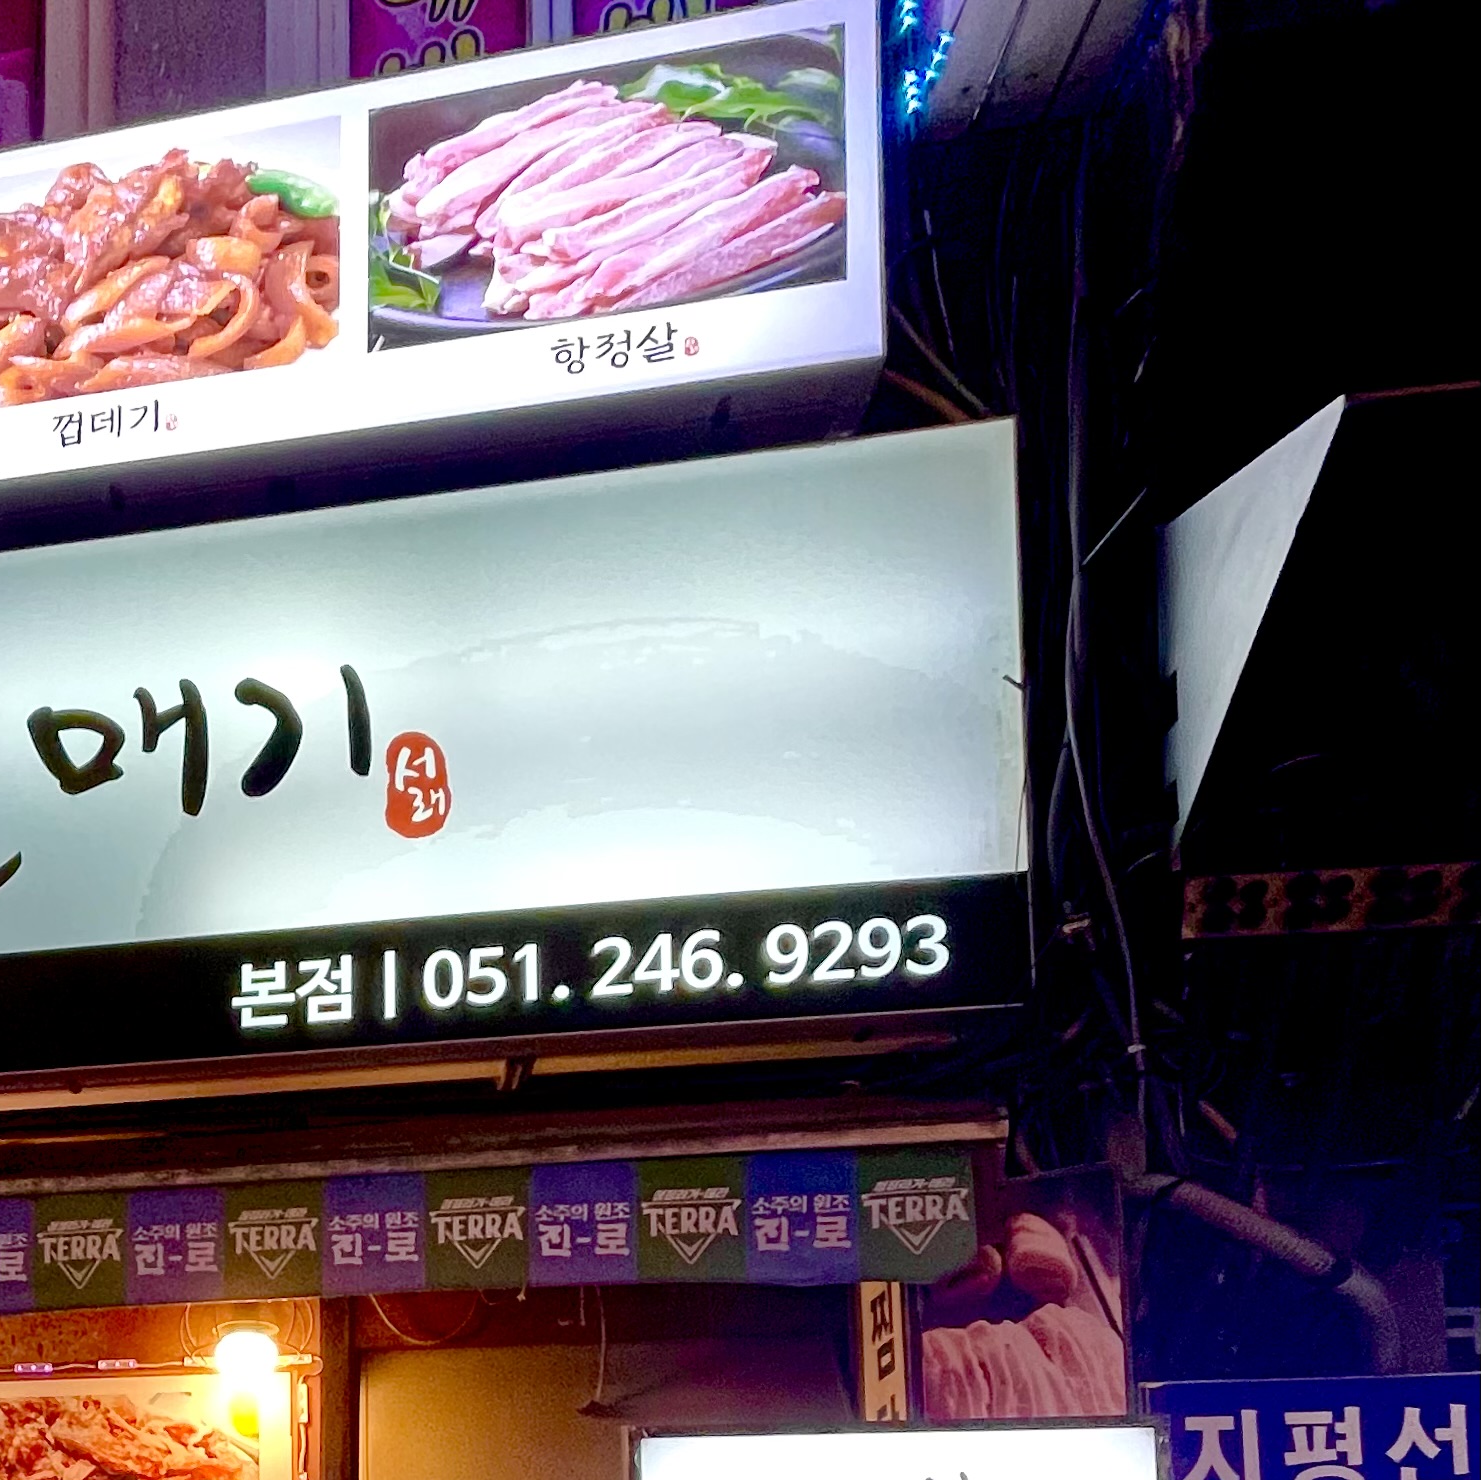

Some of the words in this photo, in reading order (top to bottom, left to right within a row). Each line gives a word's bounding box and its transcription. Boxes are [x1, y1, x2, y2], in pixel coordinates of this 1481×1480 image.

[551, 324, 678, 373] 항정살
[52, 399, 159, 448] 껍데기
[230, 952, 353, 1028] 본점
[423, 942, 570, 1010] 051.
[590, 928, 744, 998] 246.
[764, 914, 950, 986] 9293
[811, 1193, 853, 1213] 원조
[863, 1195, 971, 1230] TERRA
[433, 1211, 525, 1245] TERRA
[642, 1204, 739, 1238] TERRA
[39, 1232, 121, 1264] TERRA
[229, 1222, 318, 1255] TERRA
